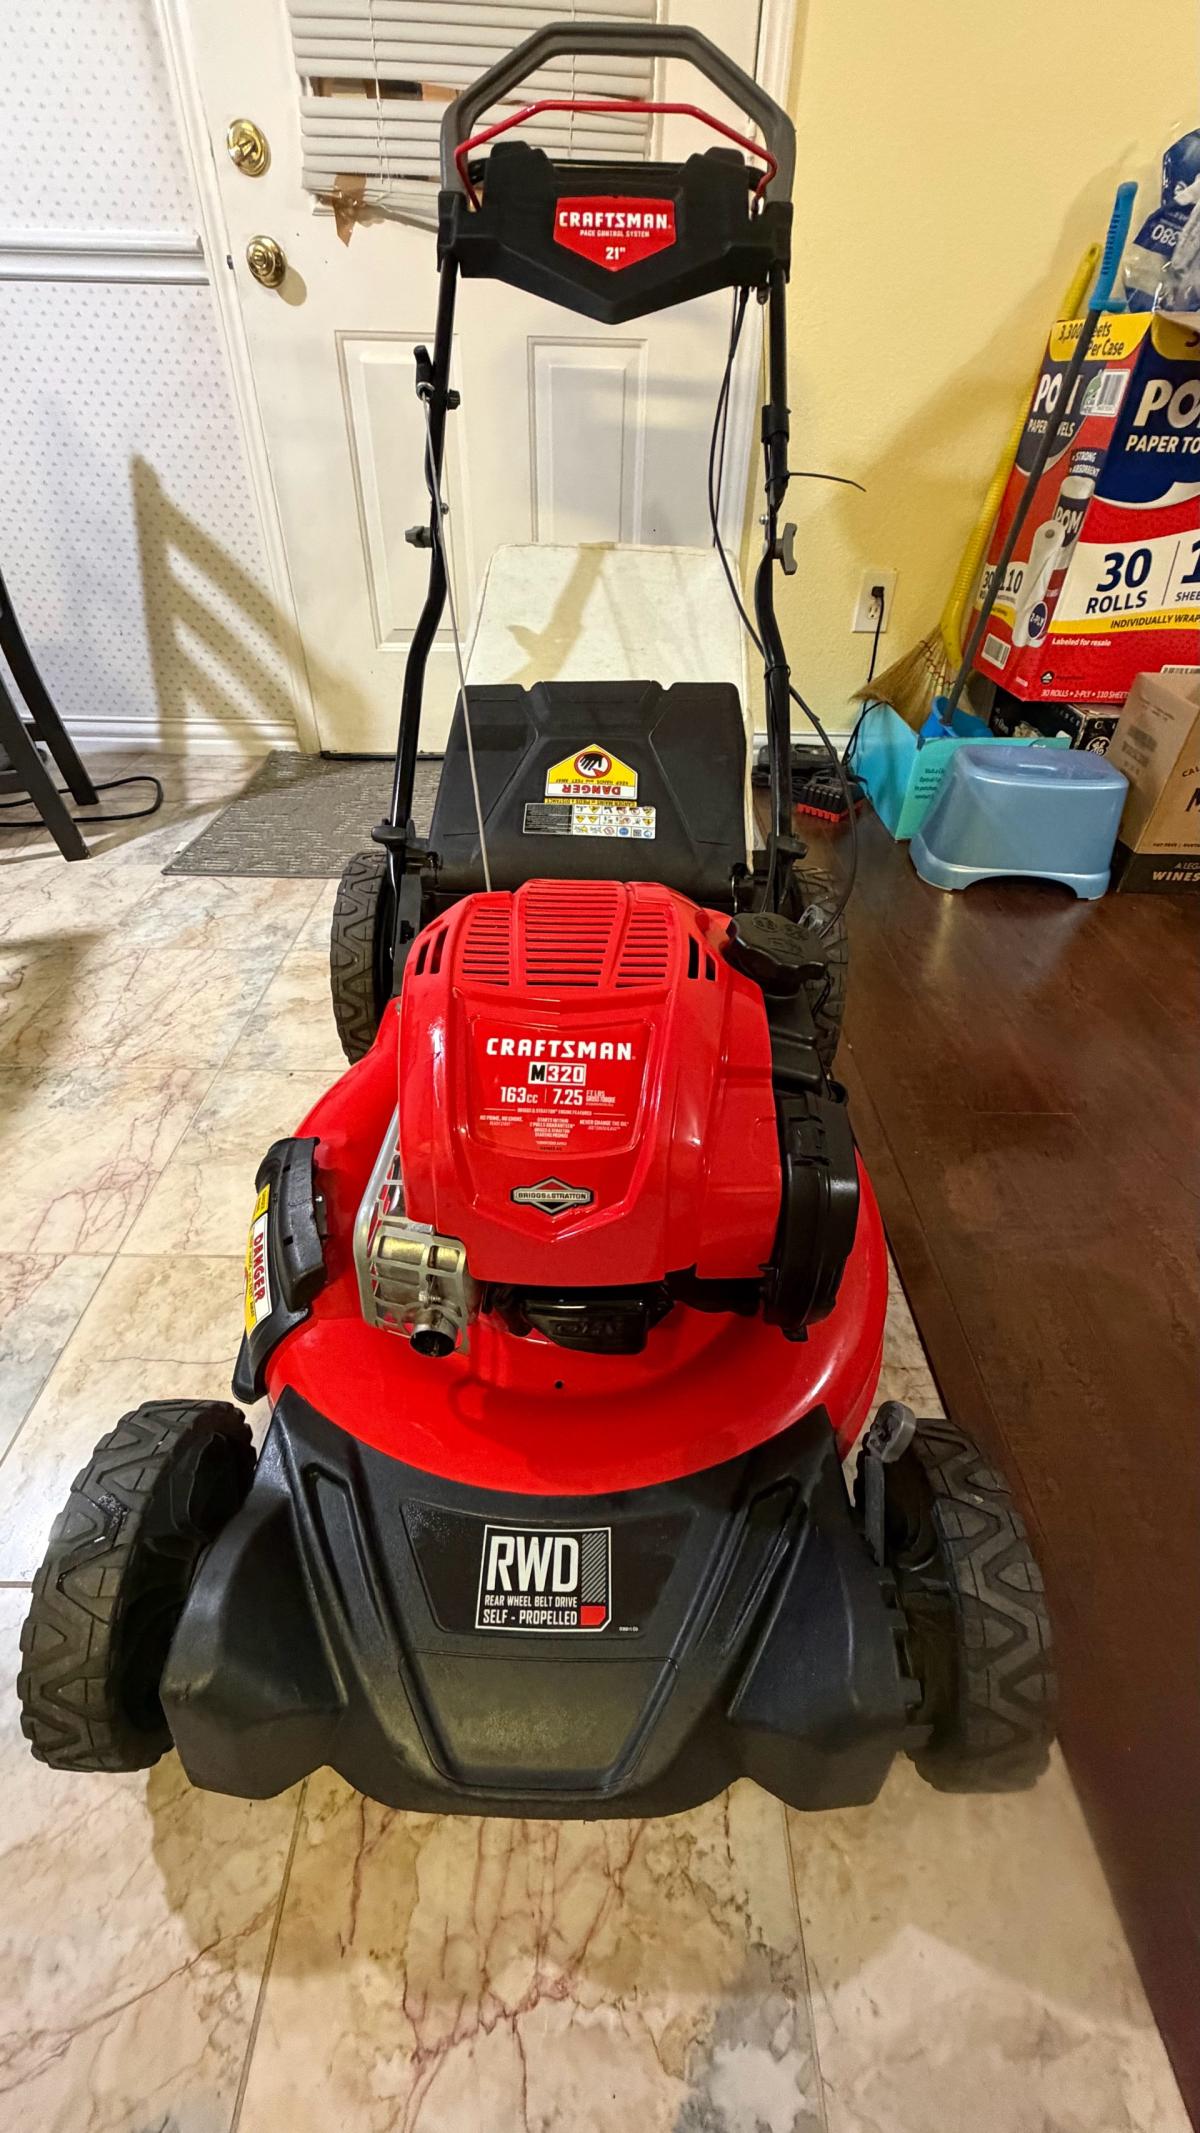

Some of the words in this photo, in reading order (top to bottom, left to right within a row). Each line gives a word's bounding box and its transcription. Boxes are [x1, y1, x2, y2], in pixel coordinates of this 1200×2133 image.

[559, 211, 668, 229] CRAFTSMAN
[579, 229, 596, 237] PACE
[597, 230, 625, 238] CONTROL
[625, 230, 650, 238] SYSTEM
[605, 246, 626, 260] 21"
[1102, 338, 1124, 355] Case
[1133, 379, 1200, 428] PO
[1028, 419, 1048, 433] PAPER
[1125, 434, 1179, 453] PAPER
[1075, 451, 1096, 462] STRONG
[1096, 548, 1152, 592] 30
[1086, 590, 1148, 614] ROLLS
[1110, 615, 1173, 629] INDIVIDUALLY
[1052, 638, 1079, 646] Labeled
[1080, 639, 1090, 647] for
[1090, 639, 1111, 647] resale
[1050, 689, 1069, 697] ROLLS
[1074, 690, 1091, 698] 2-PLY
[562, 784, 621, 796] DANGER
[486, 1038, 632, 1060] CRAFTSMAN
[531, 1064, 584, 1083] M320
[552, 1088, 584, 1105] 7.25
[253, 1231, 266, 1302] DANGER
[486, 1535, 579, 1592] RWD
[484, 1594, 505, 1606] REAR
[507, 1595, 532, 1607] WHEEL
[534, 1595, 553, 1607] BELT
[555, 1597, 578, 1608] DRIVE
[483, 1609, 508, 1624] SELF
[519, 1610, 578, 1626] PROPELLED
